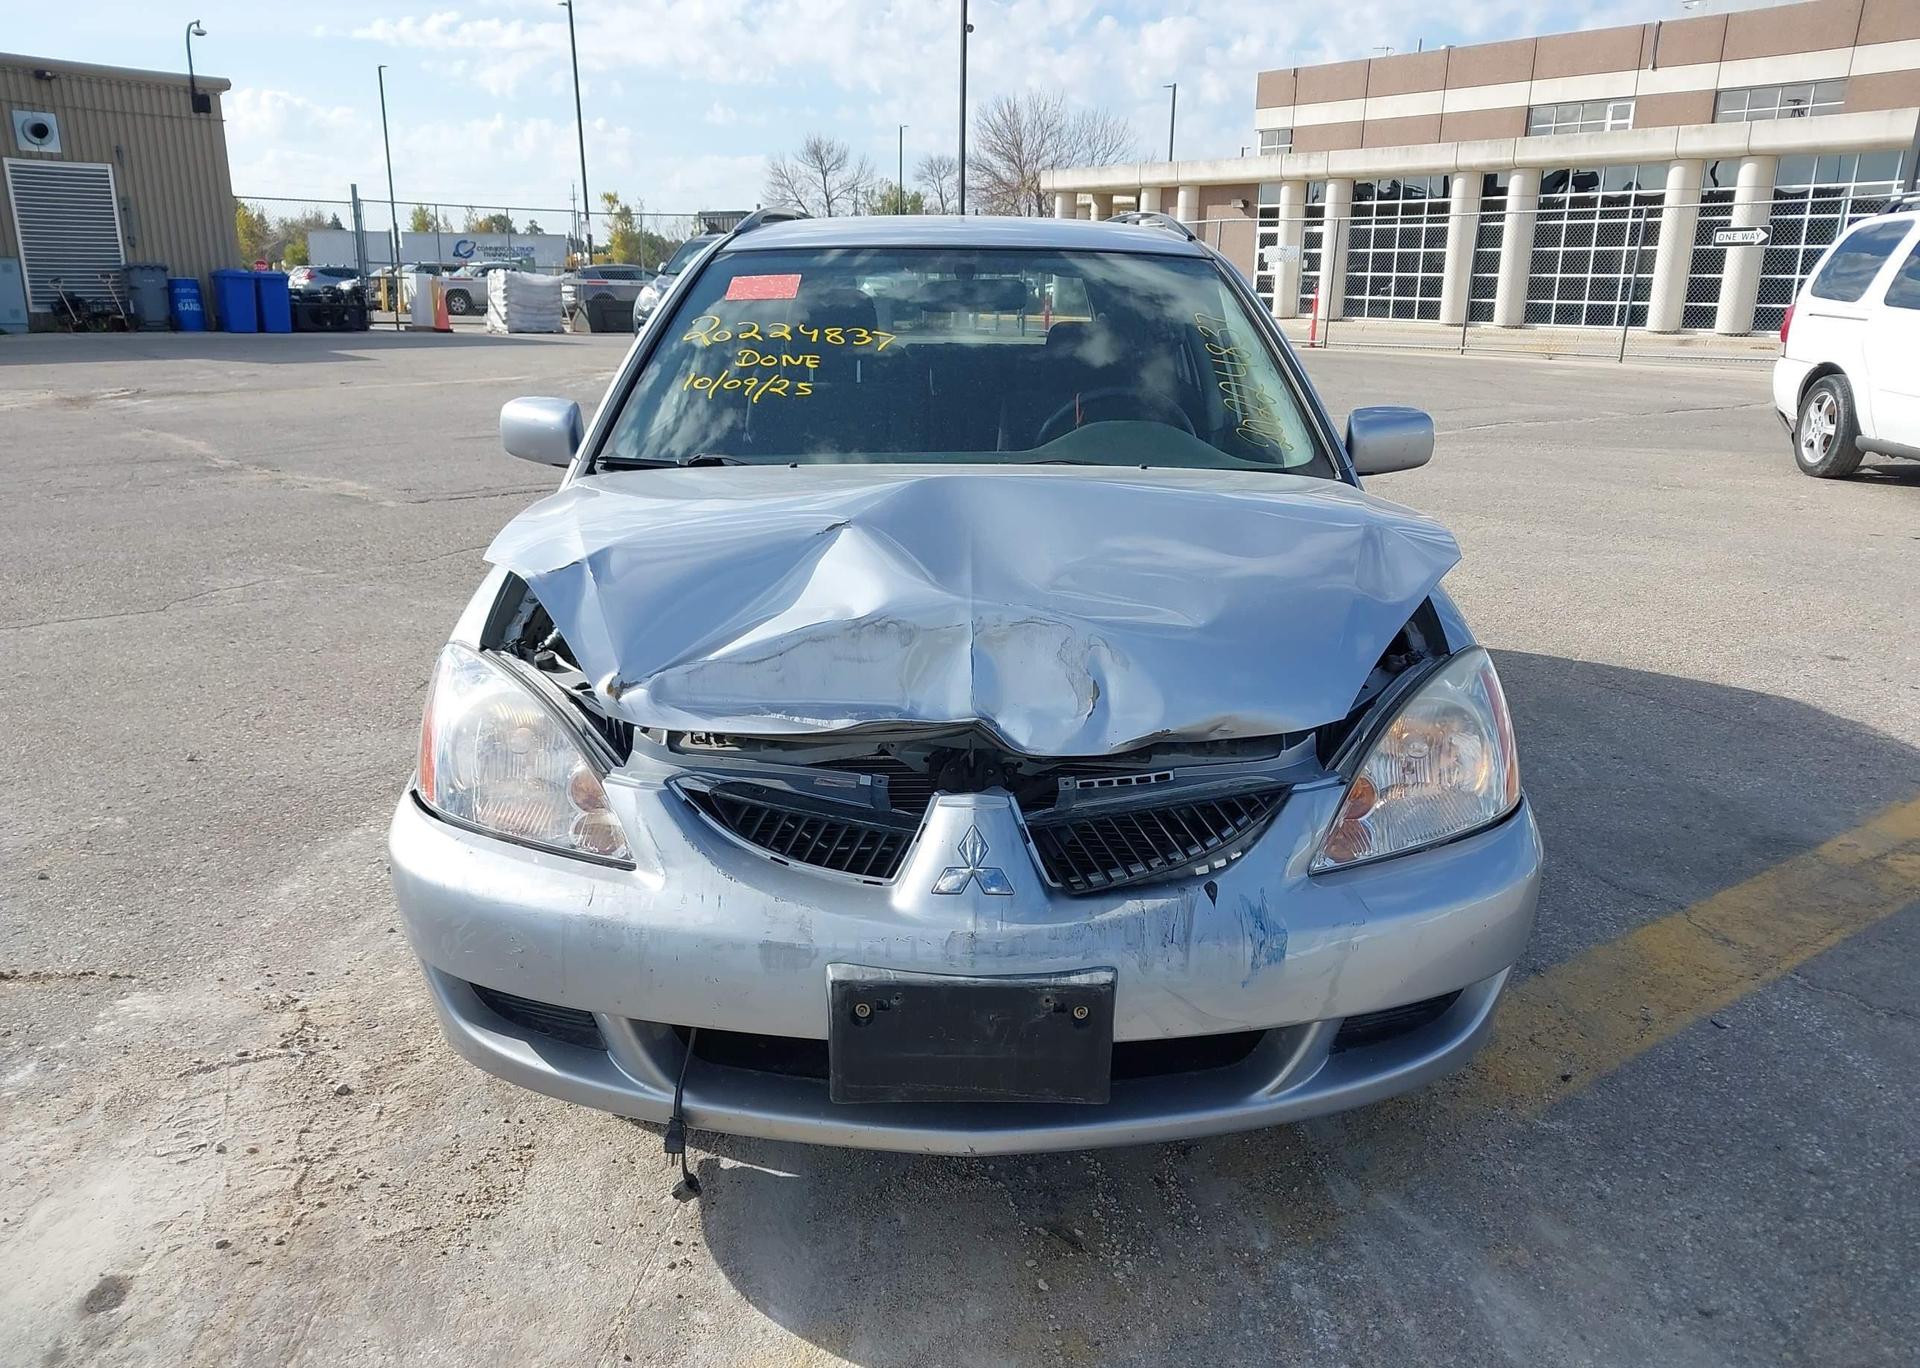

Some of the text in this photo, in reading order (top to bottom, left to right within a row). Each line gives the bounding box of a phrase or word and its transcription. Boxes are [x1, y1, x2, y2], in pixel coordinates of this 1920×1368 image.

[1718, 232, 1760, 241] ONE WAY
[177, 303, 201, 311] SAND
[682, 315, 897, 352] 20224837
[735, 349, 821, 368] DONE
[682, 370, 813, 404] 10/09/25
